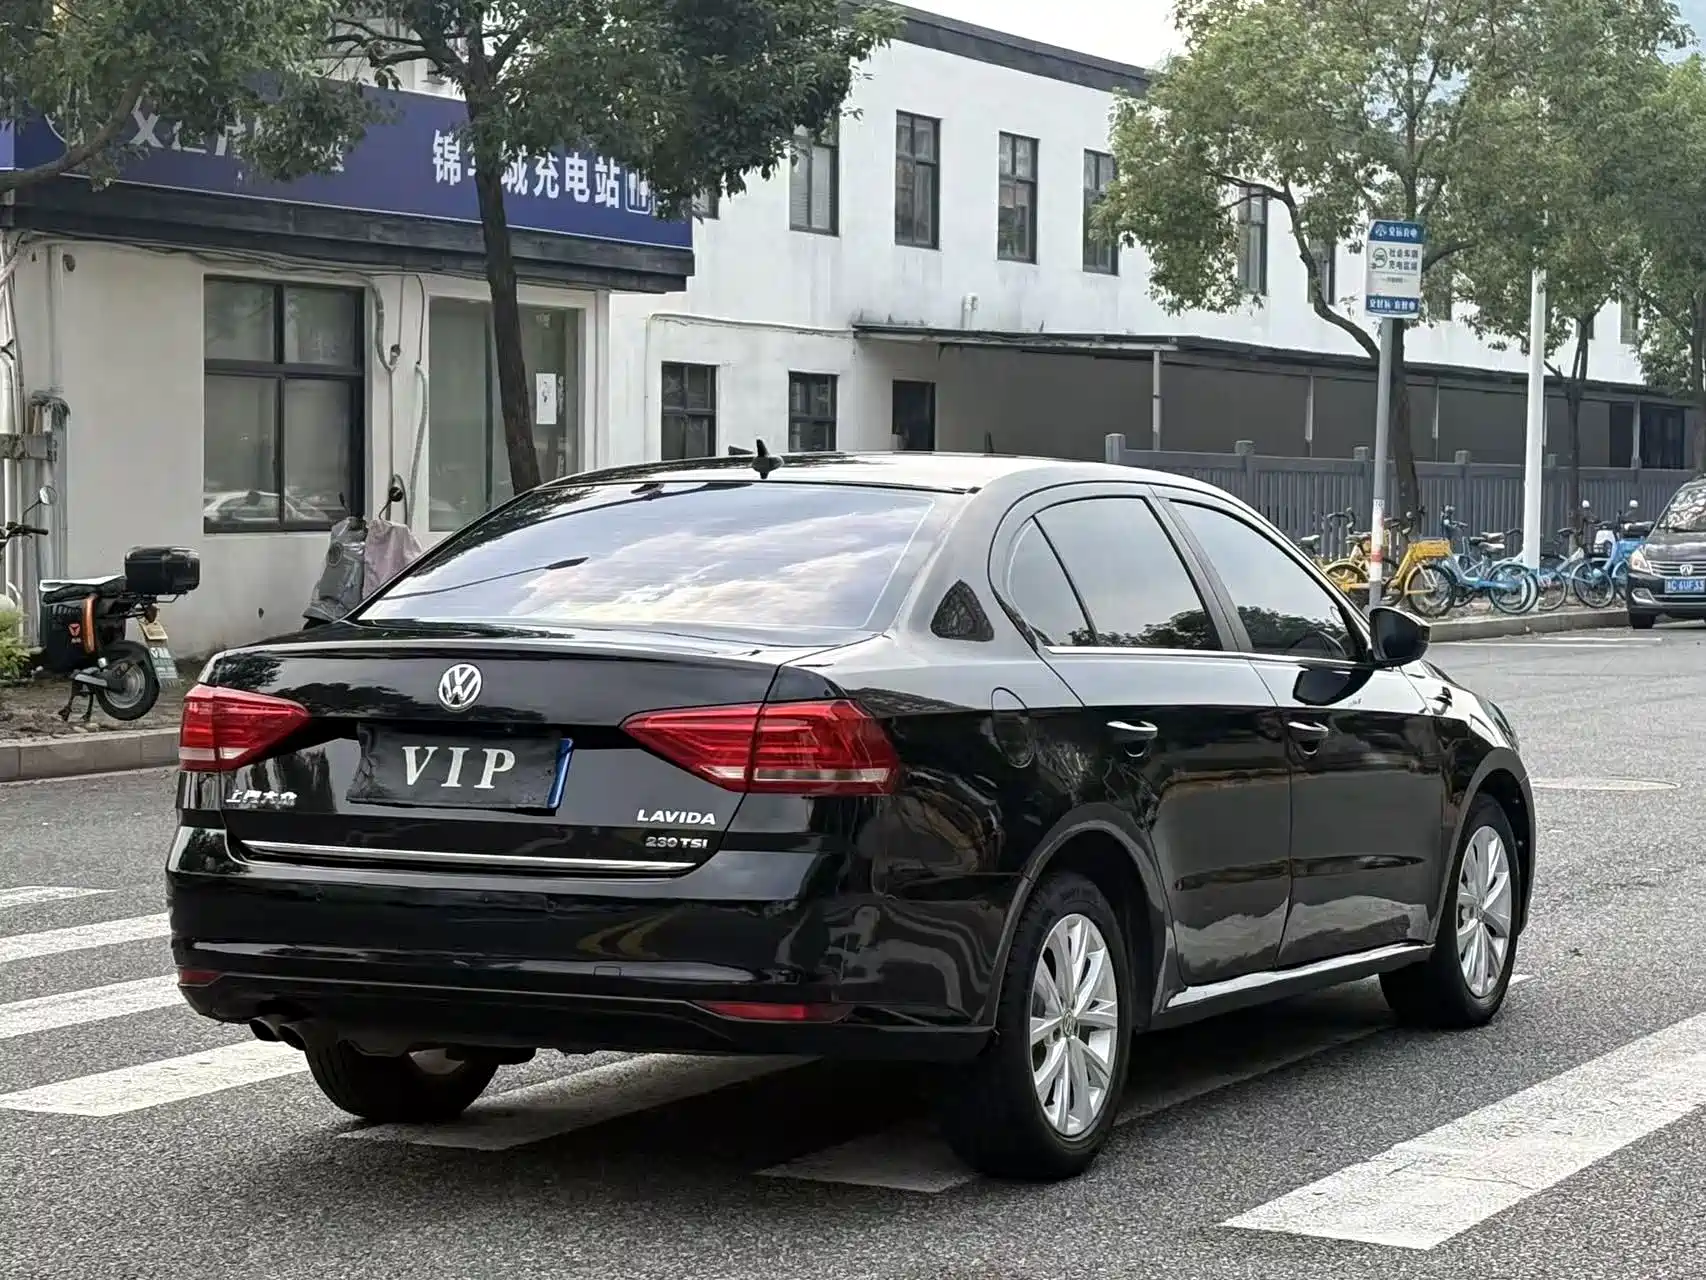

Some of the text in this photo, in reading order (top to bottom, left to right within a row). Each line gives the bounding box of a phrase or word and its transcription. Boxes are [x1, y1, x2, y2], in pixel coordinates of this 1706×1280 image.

[433, 129, 620, 209] 锦城充电站
[401, 747, 516, 789] VIP
[636, 809, 716, 825] LAVIDA
[645, 837, 709, 849] 230 TSI
